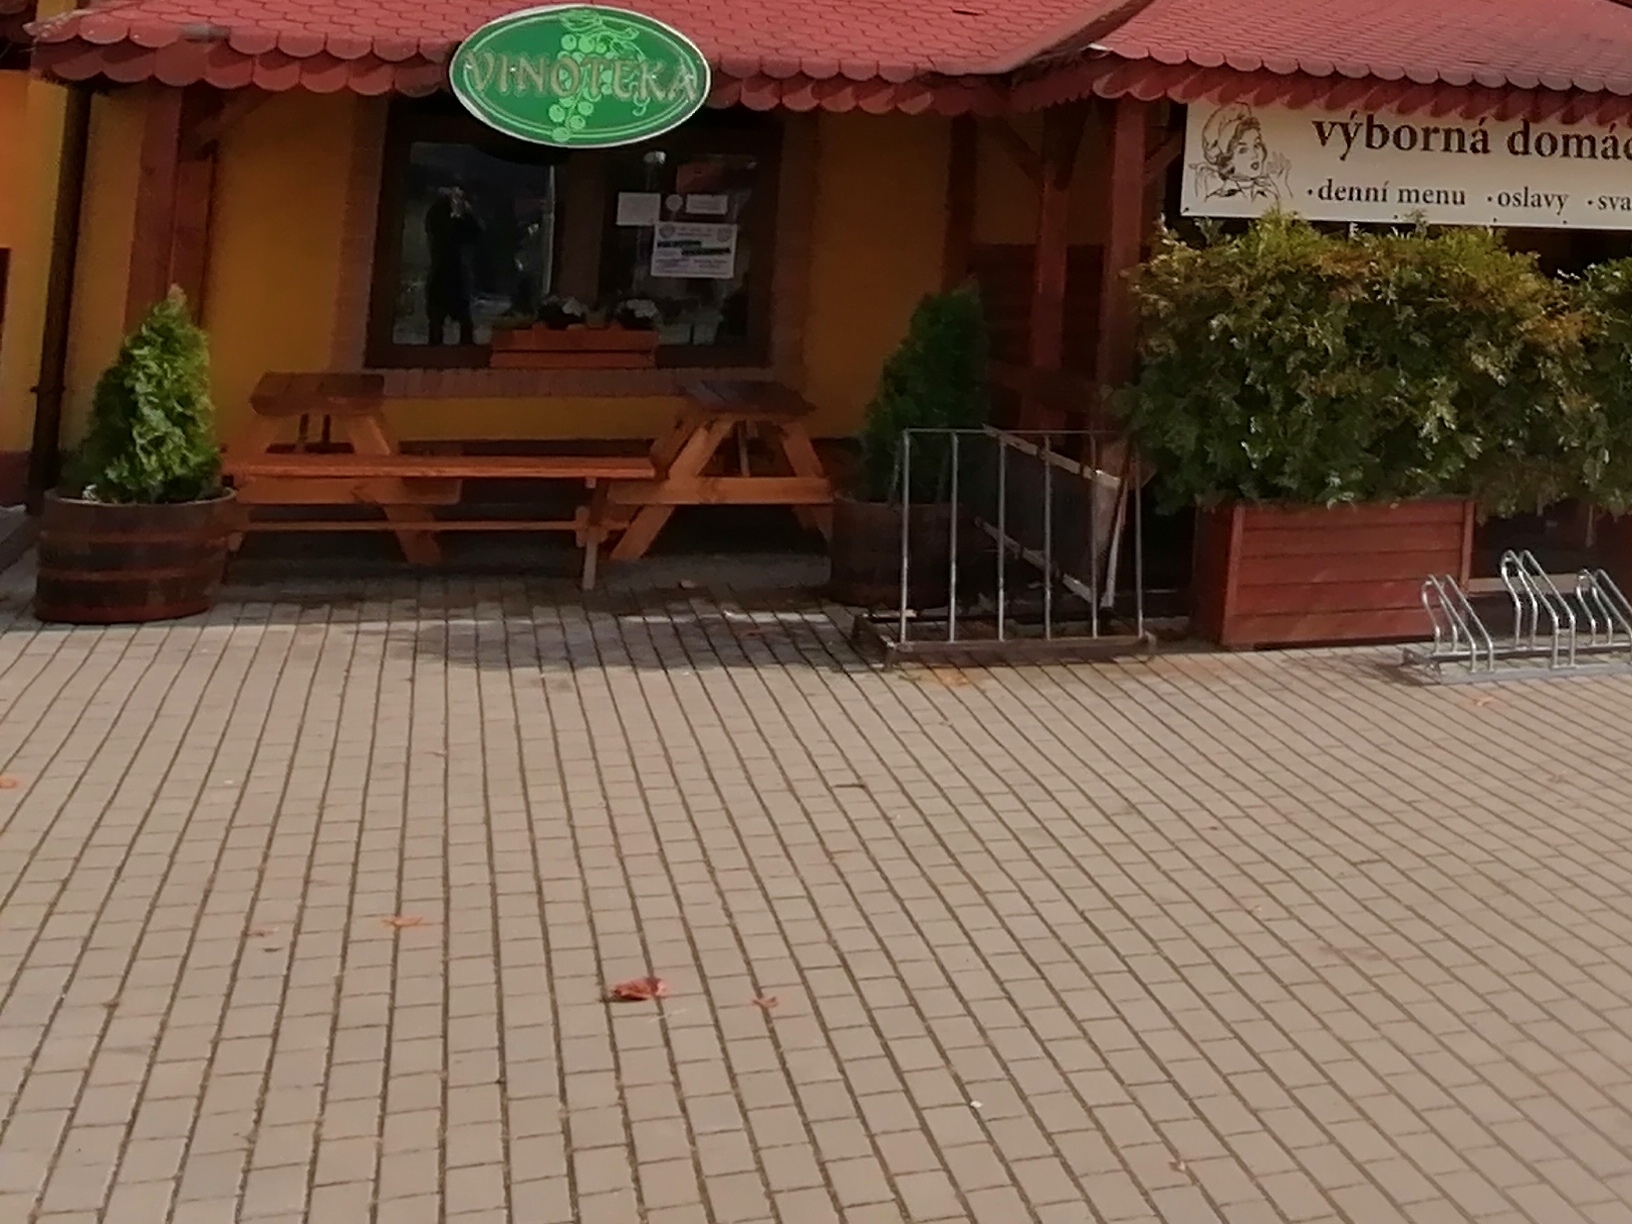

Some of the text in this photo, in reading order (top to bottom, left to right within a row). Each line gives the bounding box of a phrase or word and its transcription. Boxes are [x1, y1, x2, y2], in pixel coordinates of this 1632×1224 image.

[462, 48, 698, 102] VINOTEKA
[1311, 109, 1491, 161] výborná
[1317, 178, 1389, 203] denní
[1397, 187, 1466, 206] menu
[1497, 186, 1569, 216] oslavy
